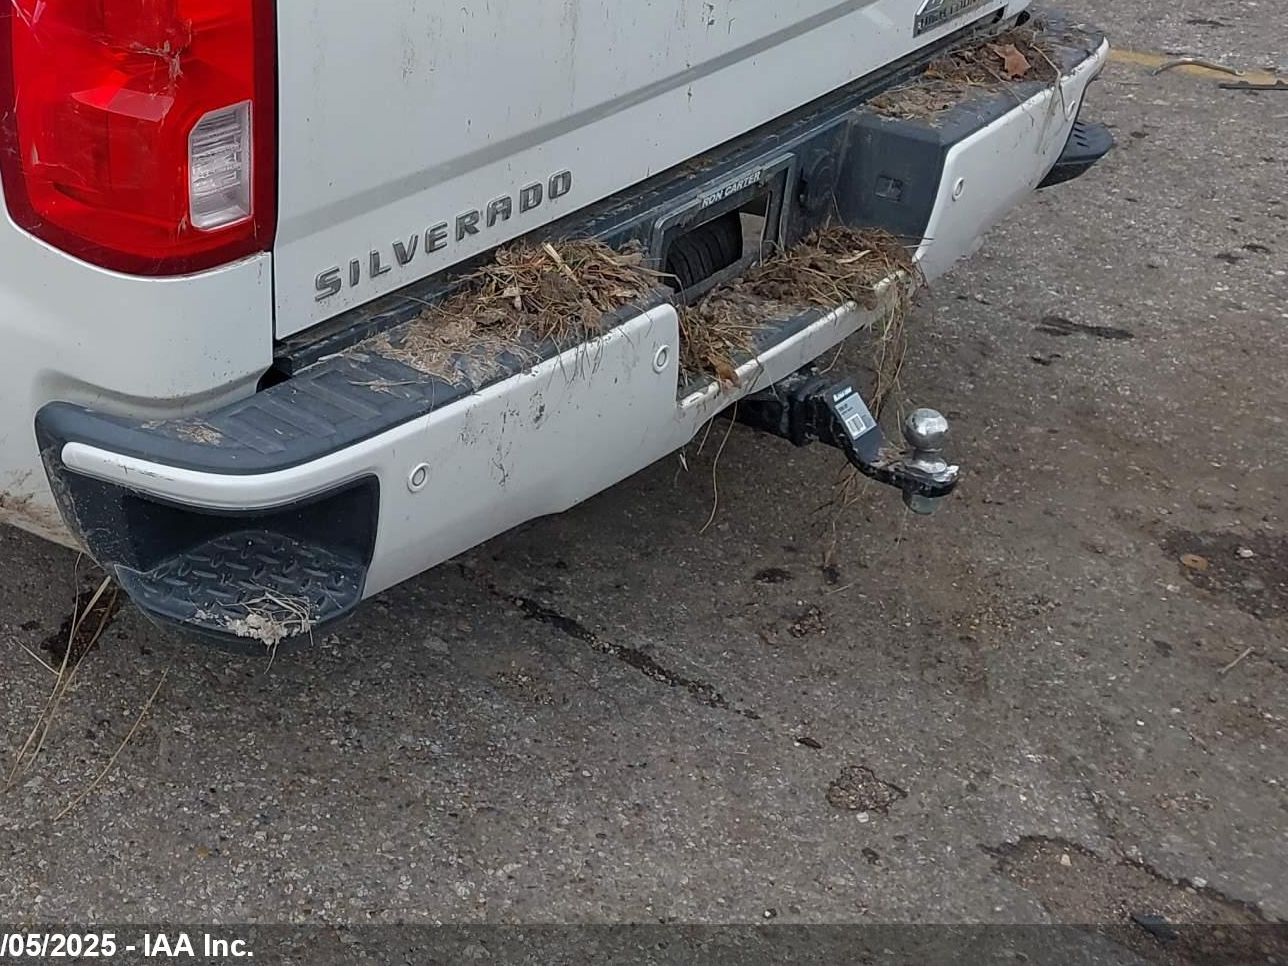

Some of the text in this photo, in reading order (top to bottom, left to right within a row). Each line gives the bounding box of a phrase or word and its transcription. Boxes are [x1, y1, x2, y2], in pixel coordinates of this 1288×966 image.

[700, 170, 761, 209] RON CARTER
[314, 168, 573, 302] SILVERADO
